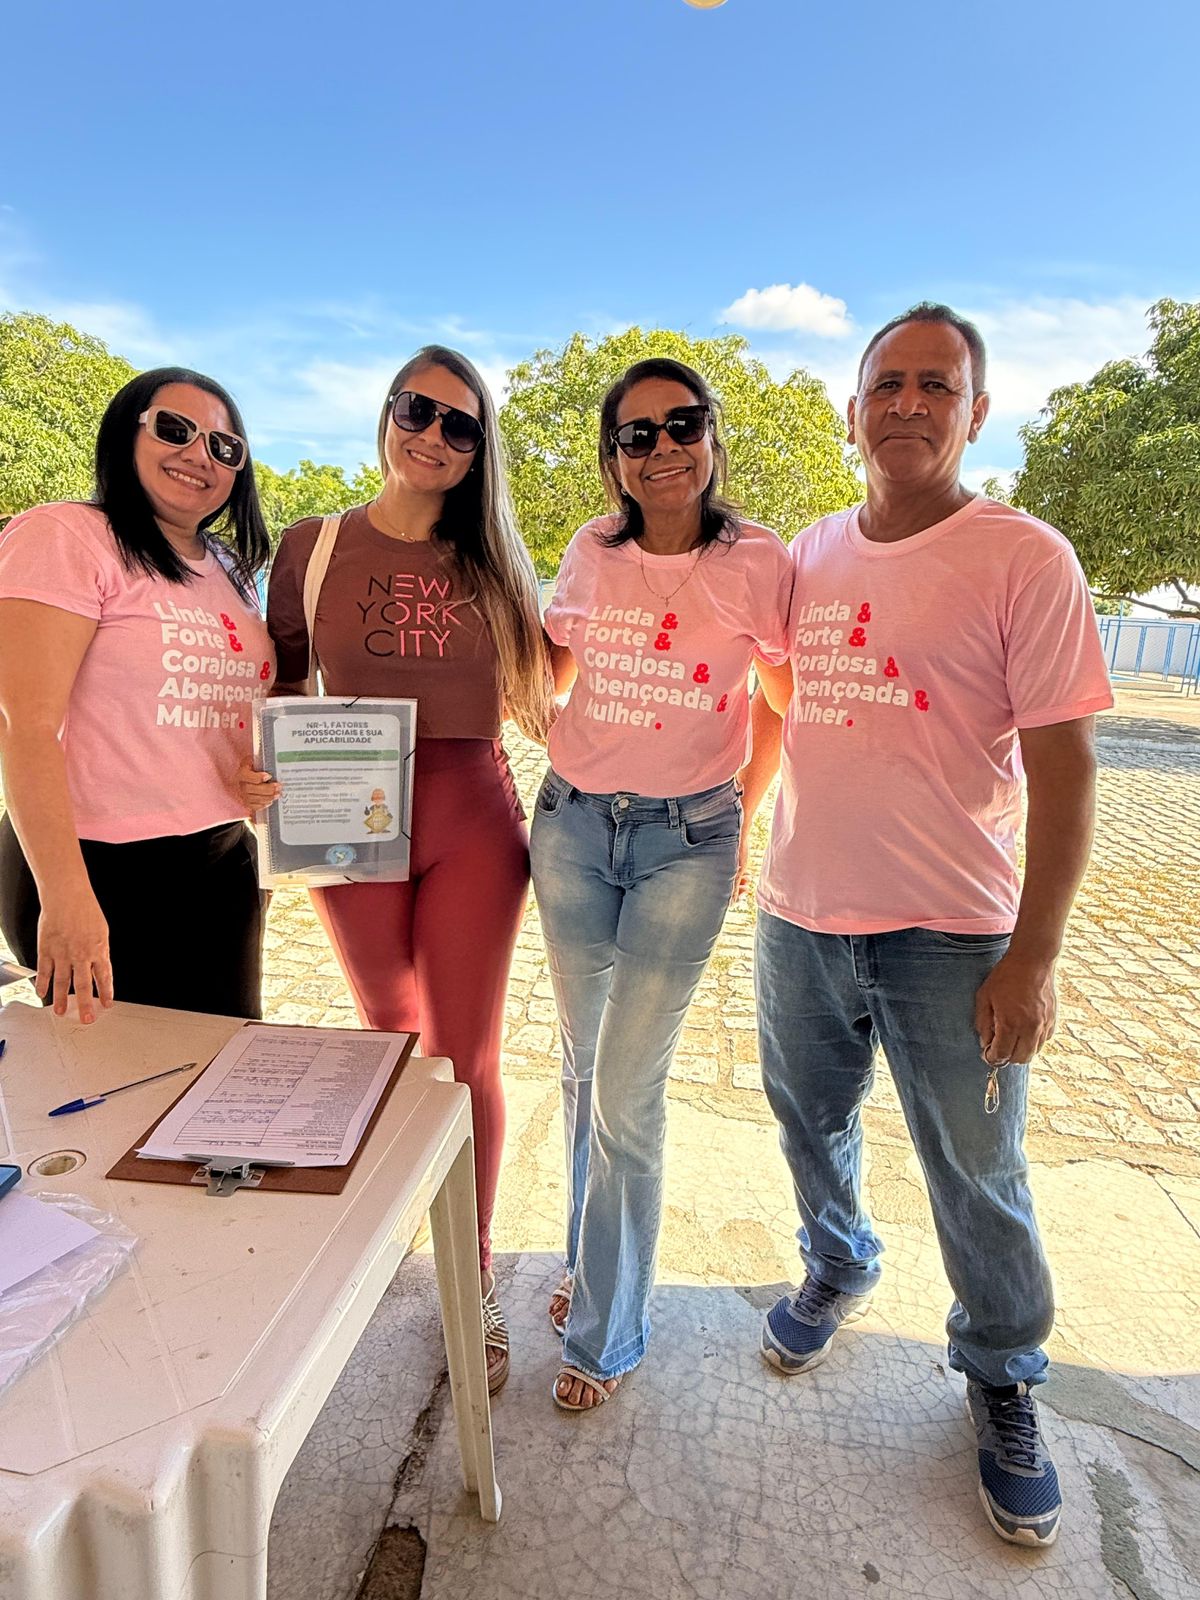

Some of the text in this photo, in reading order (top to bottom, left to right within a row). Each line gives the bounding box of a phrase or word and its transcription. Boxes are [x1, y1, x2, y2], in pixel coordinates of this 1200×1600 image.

[368, 574, 450, 599] NEW
[153, 600, 237, 631] Linda &
[357, 601, 461, 625] YORK
[589, 605, 679, 630] Linda &
[798, 600, 871, 625] Linda &
[161, 623, 243, 652] Forte &
[364, 630, 451, 657] CITY
[584, 622, 672, 651] Forte &
[795, 626, 867, 648] Forte &
[161, 649, 270, 680] Corajosa &
[583, 646, 711, 684] Corajosa &
[795, 648, 899, 678] orajosa &
[798, 675, 930, 712] bençoada &
[156, 703, 244, 729] Mulher.
[331, 721, 369, 729] FATORES
[292, 729, 383, 737] PSICOSSOCIAIS E SUA
